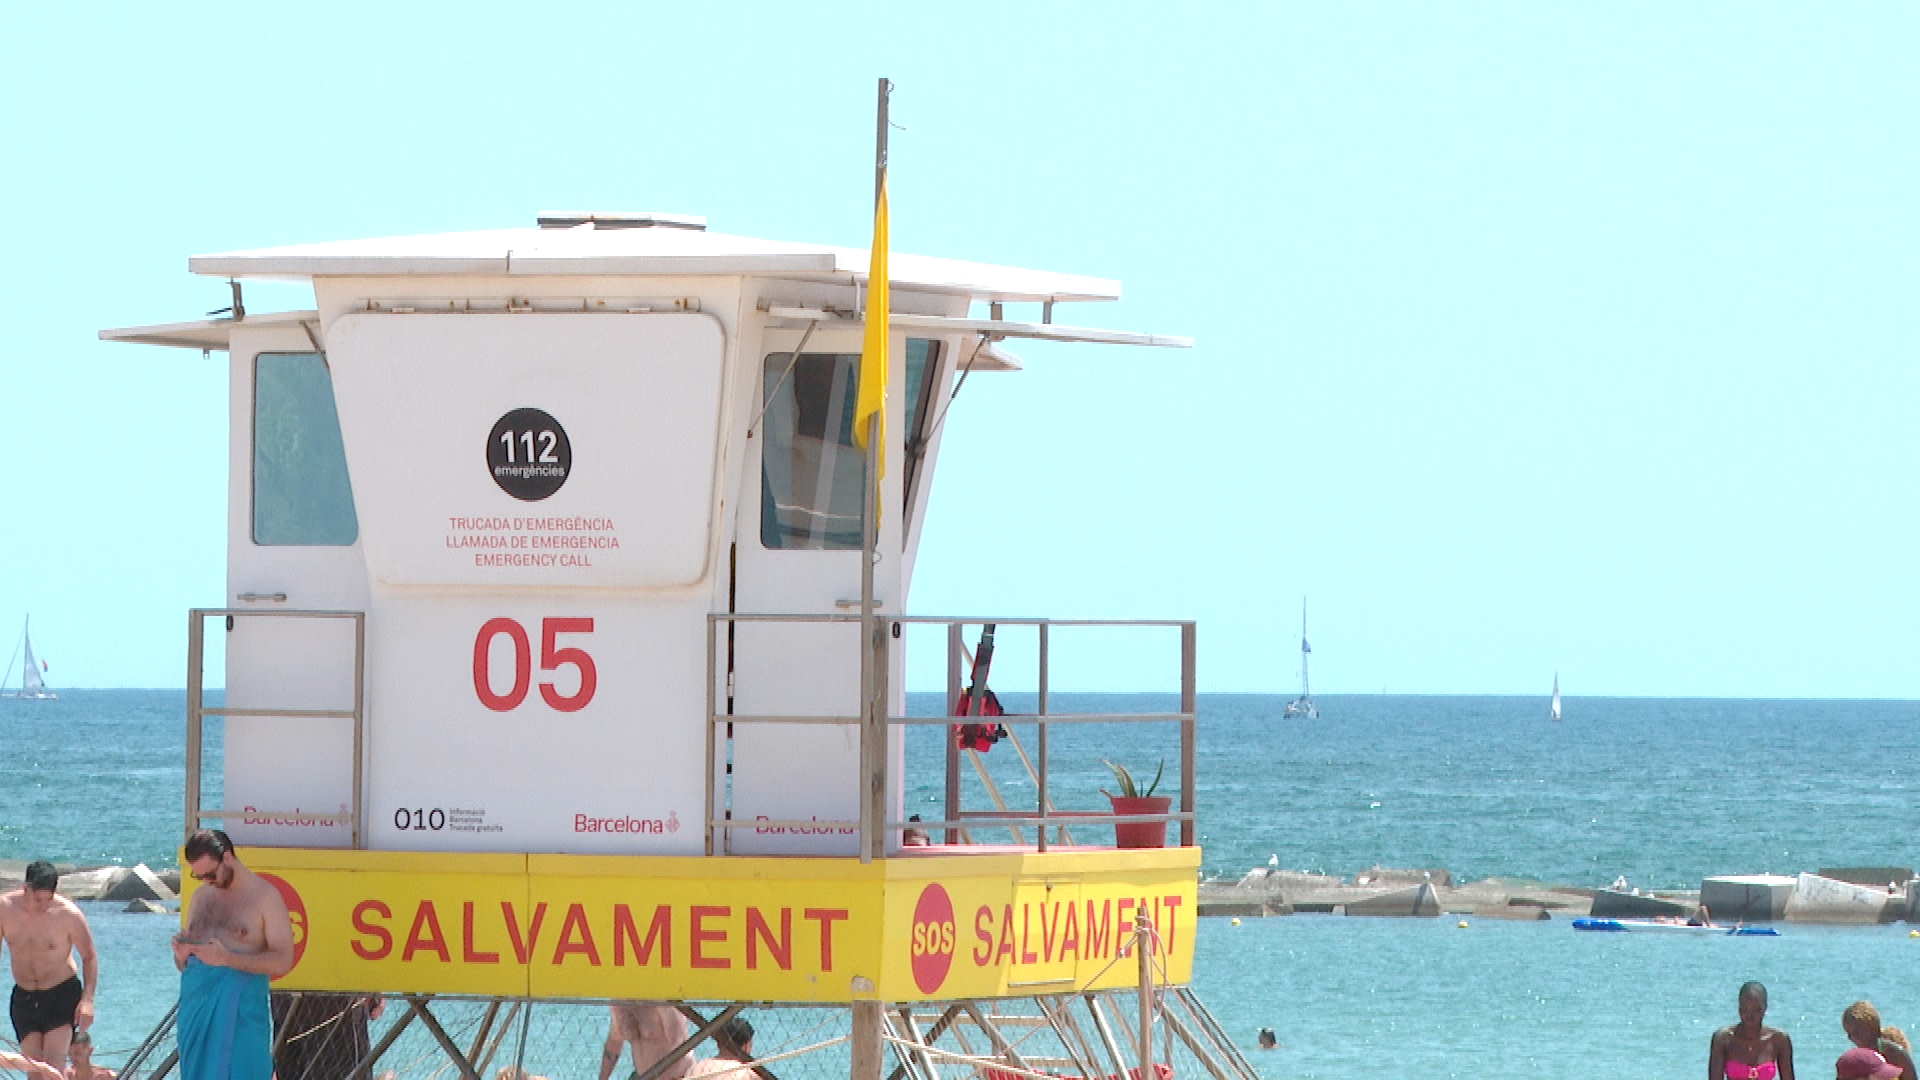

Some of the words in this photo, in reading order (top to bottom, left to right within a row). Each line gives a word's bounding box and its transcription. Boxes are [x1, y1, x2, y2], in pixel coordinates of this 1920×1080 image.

[500, 429, 558, 463] 112
[449, 517, 511, 530] TRUCADA
[446, 535, 508, 549] LLAMADA
[511, 535, 528, 549] DE
[532, 536, 620, 549] EMERGENCIA
[475, 553, 557, 567] EMERGENCY
[560, 554, 592, 567] CALL
[472, 617, 597, 712] 05
[394, 807, 445, 830] 010
[574, 813, 664, 834] Barcelona
[350, 899, 848, 972] SALVAMENT
[913, 922, 954, 956] SOS
[973, 895, 1182, 967] SALVAMENT
